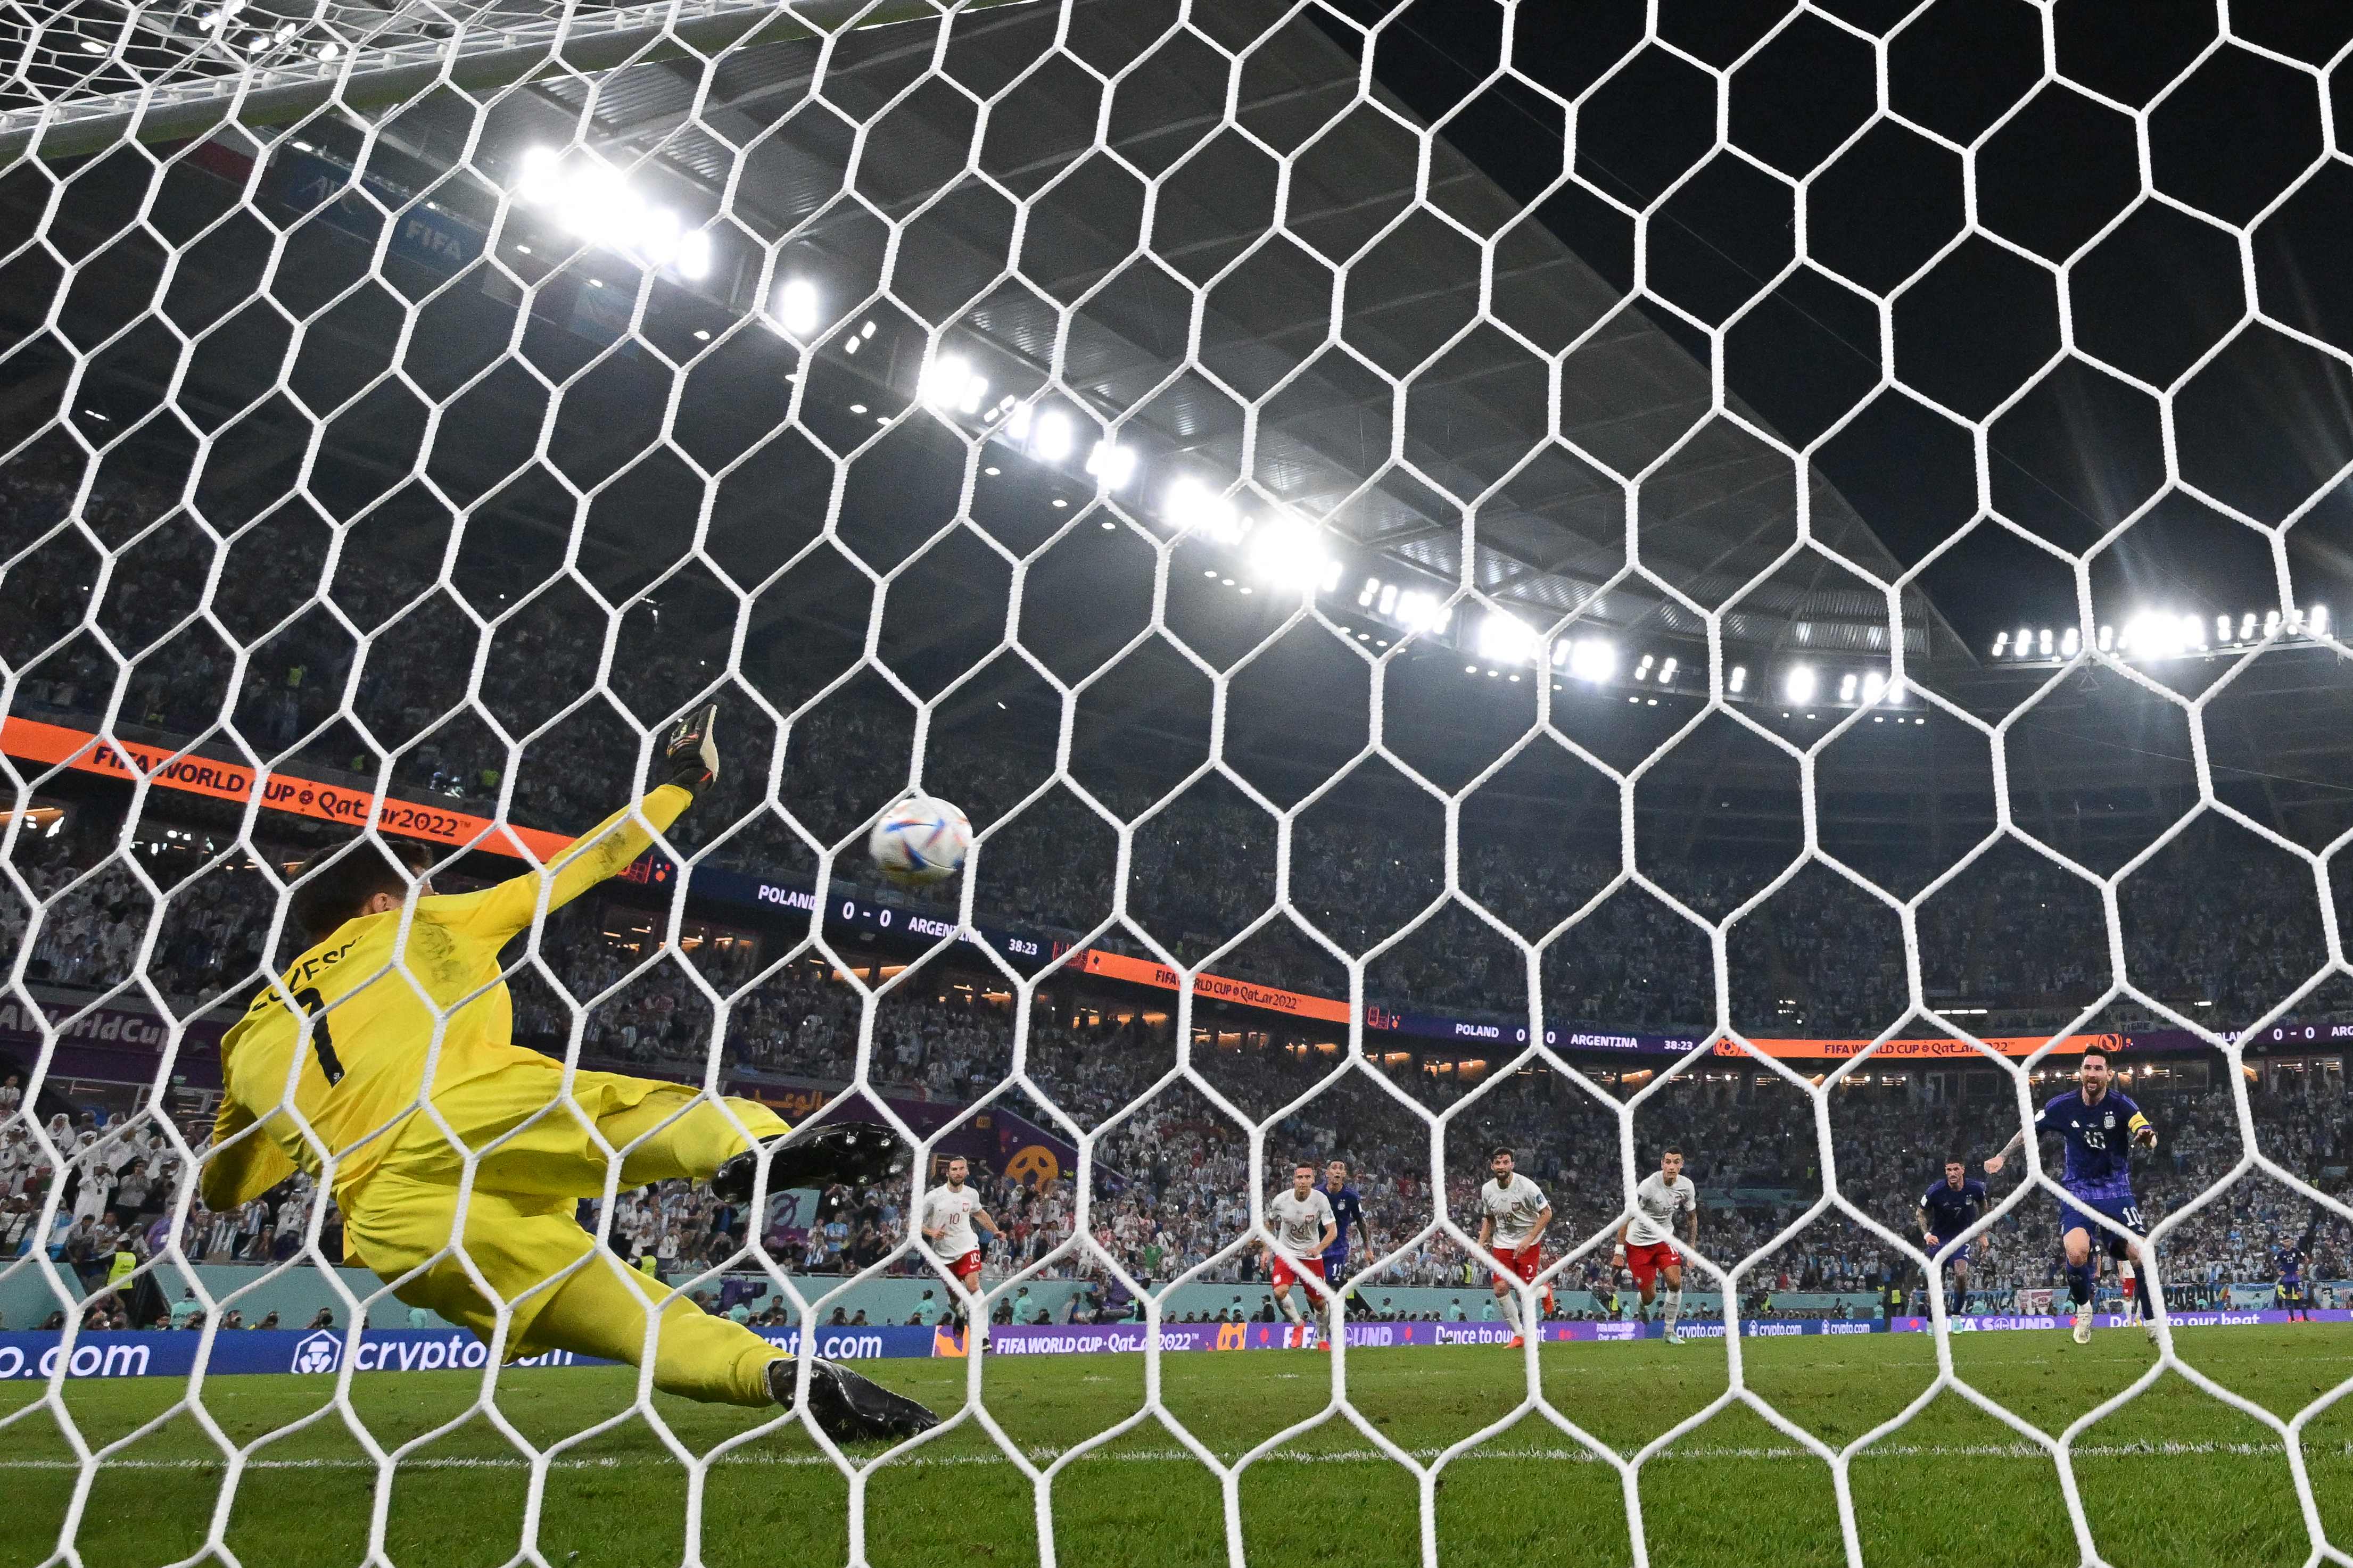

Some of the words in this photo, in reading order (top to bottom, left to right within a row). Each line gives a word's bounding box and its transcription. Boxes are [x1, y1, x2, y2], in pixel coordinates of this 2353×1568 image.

[406, 220, 461, 261] FIFA
[156, 758, 245, 792] WORLD
[843, 902, 855, 919] 0
[879, 909, 892, 927] 0
[1008, 938, 1038, 956] 38:23
[1155, 969, 1177, 985] FIFA
[1213, 981, 1232, 996] CUP
[284, 988, 345, 1089] 1
[1455, 1023, 1500, 1038] POLAND
[1516, 1029, 1526, 1042] 0
[1546, 1031, 1556, 1044] 0
[1570, 1034, 1638, 1049] ARGENTINA
[1664, 1040, 1694, 1051] 38:23
[2273, 1028, 2283, 1041] 0
[2305, 1027, 2315, 1039] 0
[1824, 1044, 1849, 1054] FIFA
[1896, 1044, 1919, 1054] CUP
[950, 1213, 960, 1224] 10
[1954, 1207, 1962, 1218] 7
[2122, 1206, 2143, 1227] 10
[970, 1252, 980, 1264] 10
[1332, 1263, 1342, 1276] 11
[2168, 1316, 2184, 1326] to
[2187, 1317, 2218, 1326] our
[2222, 1313, 2260, 1325] beat
[1435, 1325, 1476, 1345] Dance
[1479, 1326, 1492, 1345] to
[1759, 1323, 1802, 1336] crypto.com
[1830, 1322, 1870, 1334] crypto.com
[996, 1337, 1026, 1354] FIFA
[1027, 1337, 1076, 1354] WORLD
[1077, 1336, 1103, 1353] CUP
